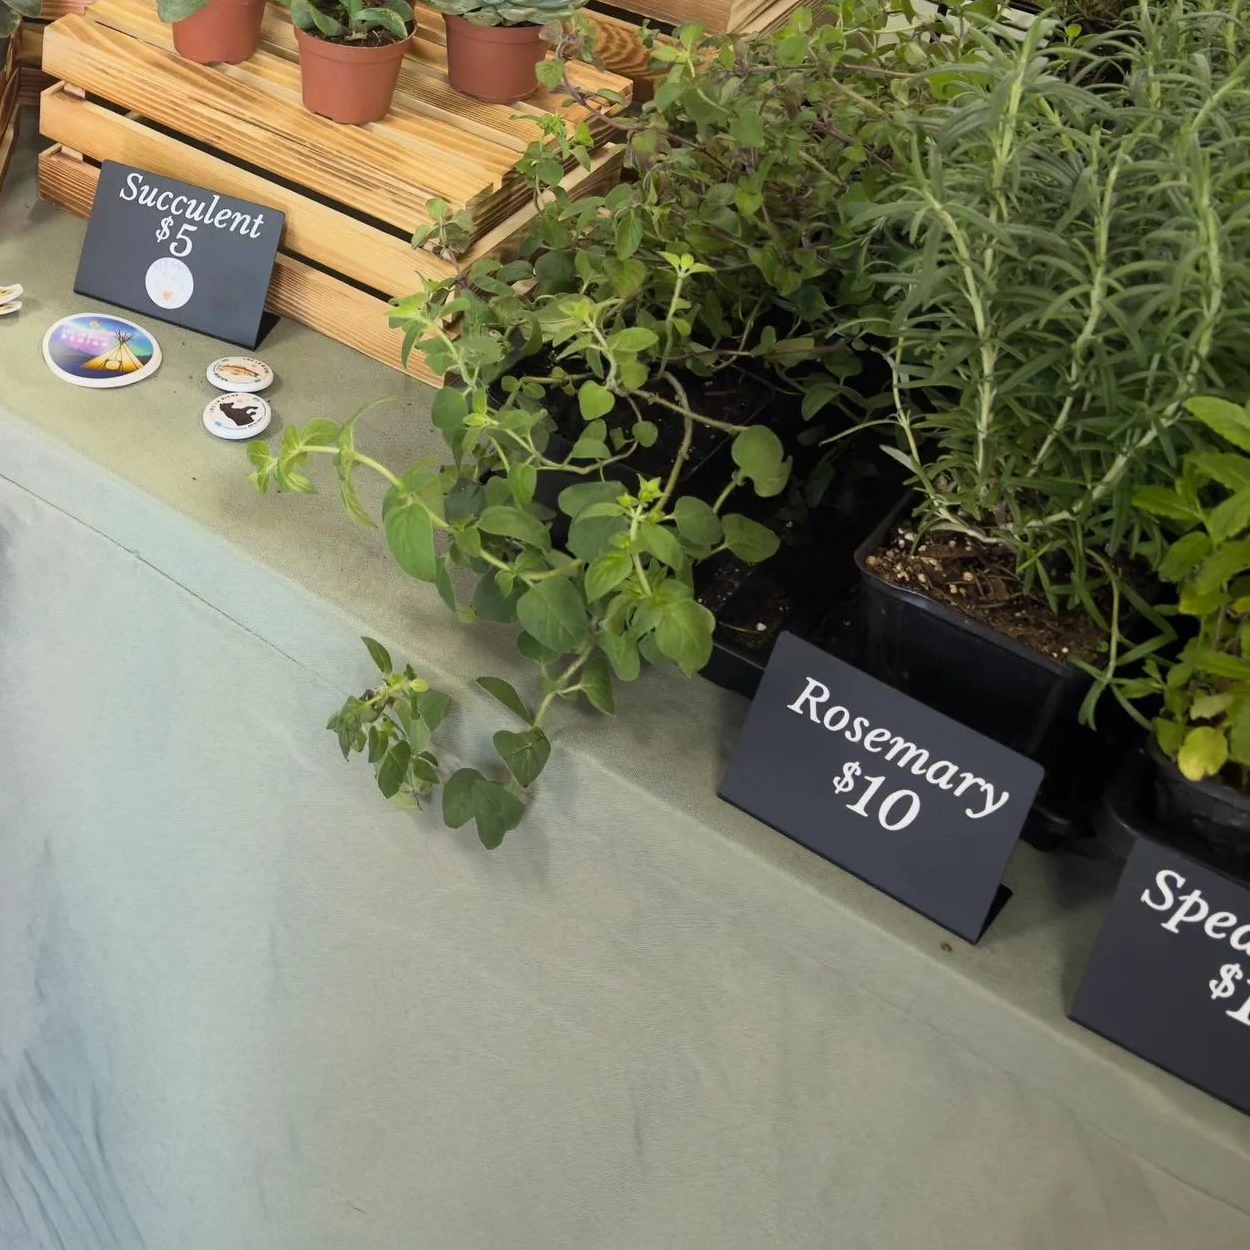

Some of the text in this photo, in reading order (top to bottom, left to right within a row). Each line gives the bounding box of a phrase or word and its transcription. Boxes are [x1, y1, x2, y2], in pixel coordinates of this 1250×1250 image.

[118, 171, 267, 241] Succulent
[155, 216, 195, 259] $5
[786, 676, 1011, 821] Rosemary
[831, 760, 922, 832] $10
